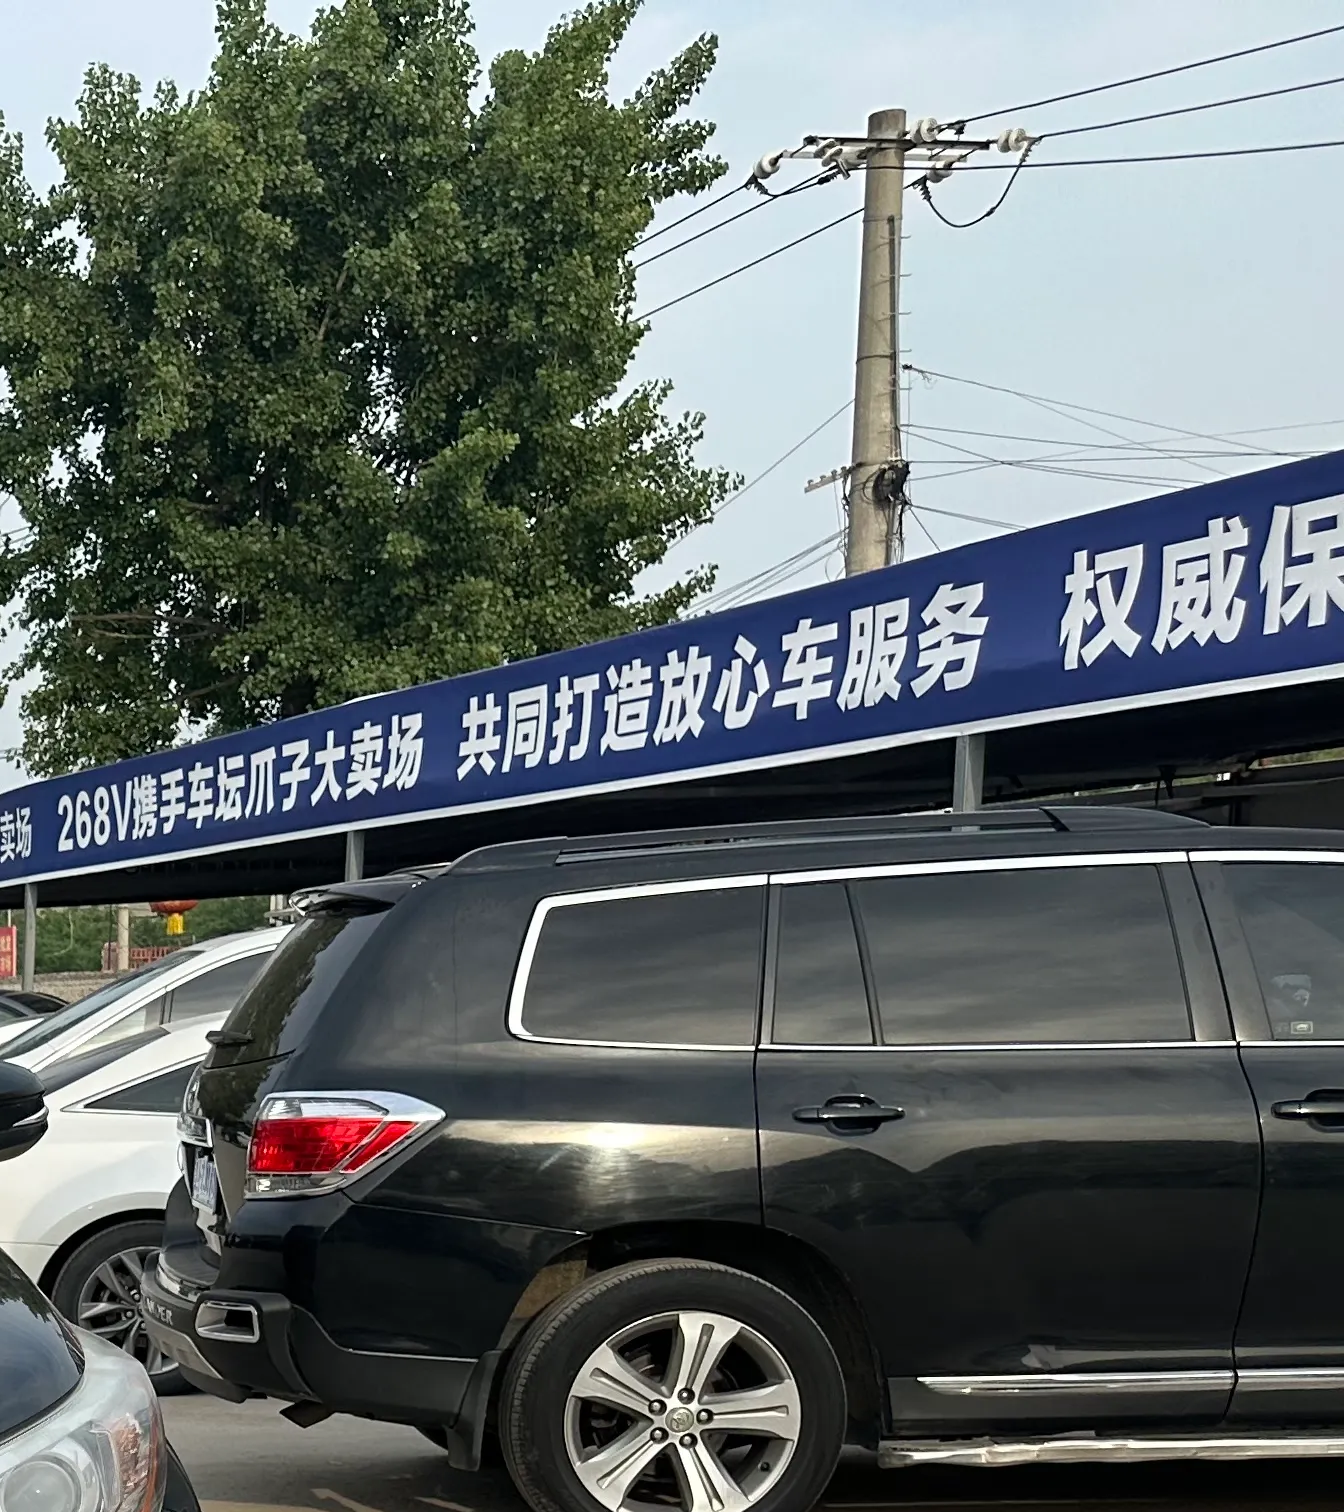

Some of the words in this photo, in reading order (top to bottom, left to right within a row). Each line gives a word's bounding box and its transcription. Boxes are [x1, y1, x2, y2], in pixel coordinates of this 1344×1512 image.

[57, 712, 424, 853] 268V携手车坛爪子大卖场
[456, 581, 990, 779] 共同打造放心车服务
